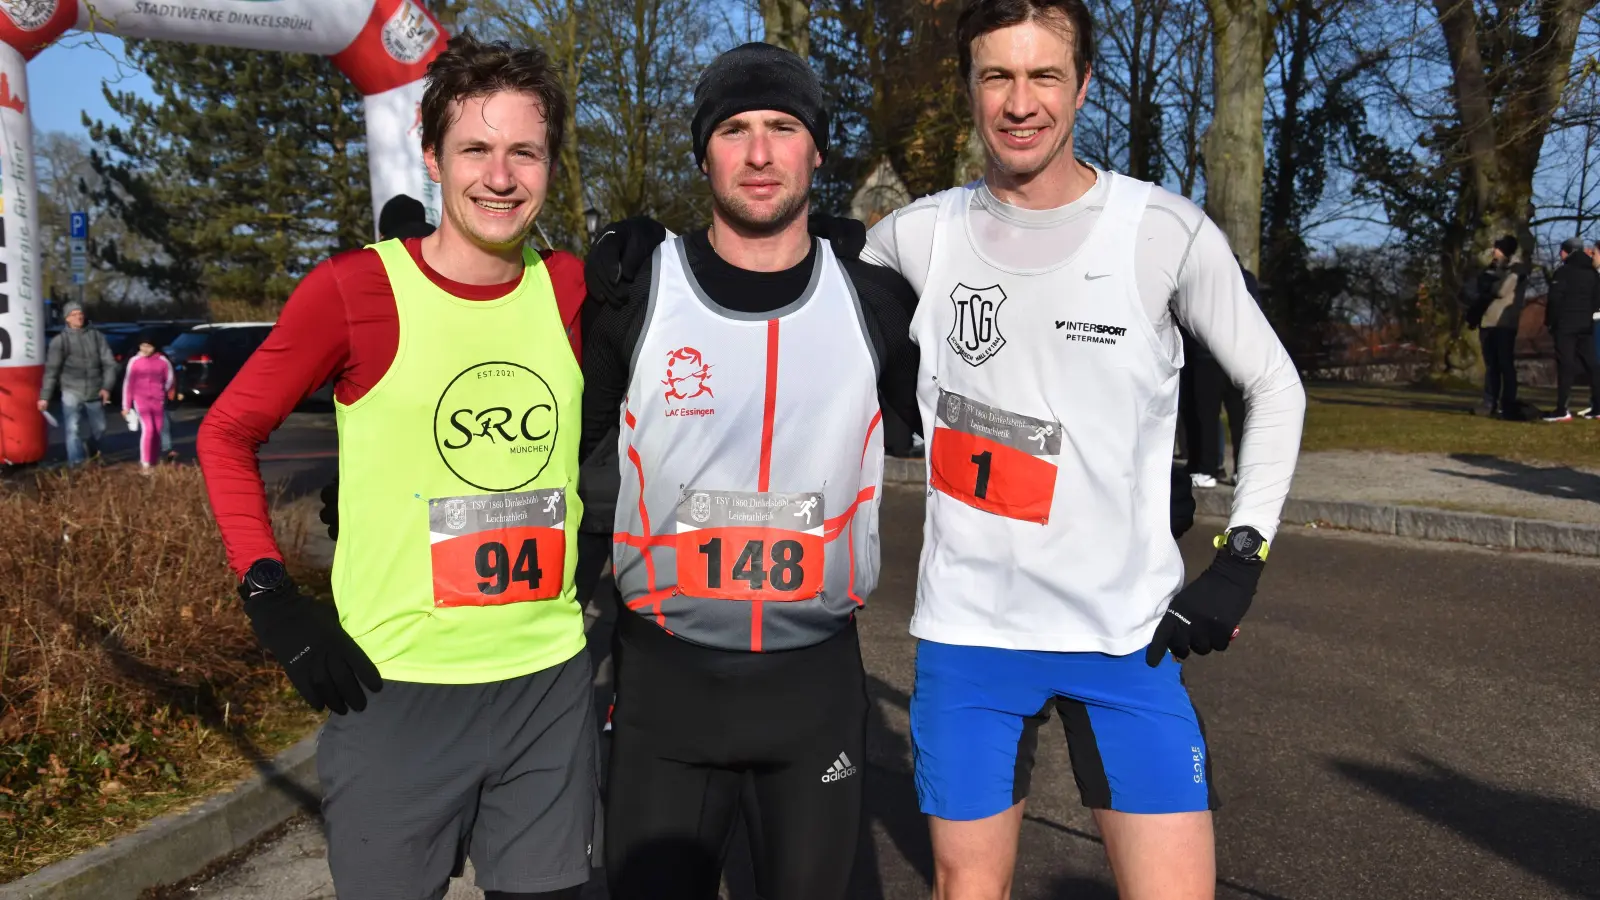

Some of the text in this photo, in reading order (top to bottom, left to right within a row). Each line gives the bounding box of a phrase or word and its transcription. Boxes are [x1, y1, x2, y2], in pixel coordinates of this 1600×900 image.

[134, 1, 313, 31] STADTWERKE DINKELSBÜHL
[73, 215, 82, 235] P
[11, 140, 35, 360] mehr Energie für hier
[957, 294, 993, 351] TSG
[1066, 321, 1127, 336] INTERSPORT
[1066, 334, 1116, 345] PETERMANN
[477, 370, 515, 379] EST.2021
[665, 408, 715, 417] LAC Essingen
[443, 404, 552, 449] SRC
[510, 445, 549, 454] MÜNCHEN
[971, 450, 992, 500] 1
[470, 500, 487, 509] TSV
[504, 495, 539, 508] Dinkelsbühl
[714, 496, 790, 508] TSV 1860 Dinkelsbühl
[486, 512, 528, 523] Leichtathletik
[728, 510, 774, 522] Leichtathletik
[474, 537, 543, 595] 94
[699, 537, 805, 592] 148
[289, 646, 311, 664] HEAD
[1191, 745, 1201, 784] GORE
[821, 766, 857, 783] adidas
